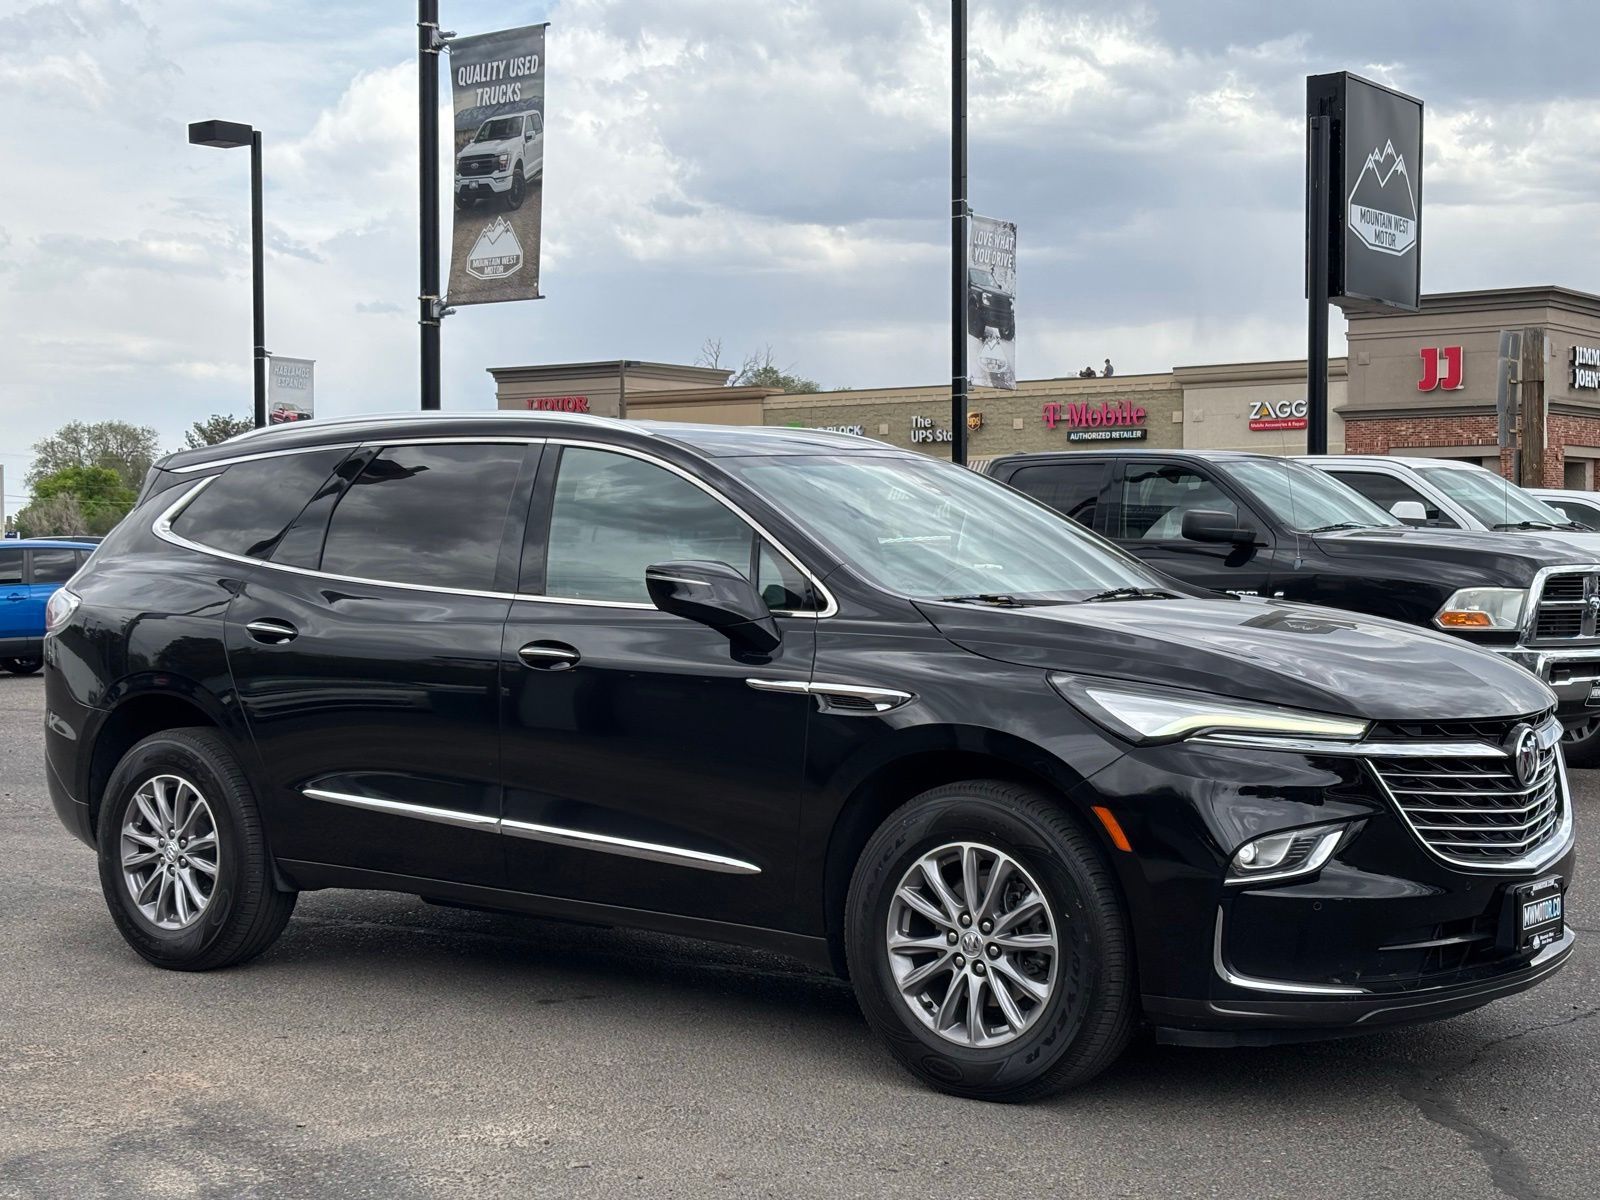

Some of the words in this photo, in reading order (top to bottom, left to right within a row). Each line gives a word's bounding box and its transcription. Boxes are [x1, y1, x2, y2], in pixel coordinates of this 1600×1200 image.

[458, 60, 506, 86] QUALITY
[509, 55, 539, 77] USED
[476, 82, 521, 106] TRUCKS
[1360, 208, 1393, 229] MOUNTAIN
[1393, 216, 1409, 234] WEST
[974, 230, 993, 246] LOVE
[994, 233, 1014, 251] WHAT
[1374, 228, 1396, 247] MOTOR
[472, 257, 501, 268] MOUNTAIN
[501, 255, 517, 265] WEST
[974, 247, 990, 264] YOU
[991, 251, 1013, 268] DRIVE
[484, 265, 504, 275] MOTOR
[1574, 345, 1600, 367] JIMM
[274, 365, 310, 378] HABLAMOS
[1249, 400, 1307, 419] ZAGG
[911, 415, 933, 428] The
[911, 431, 933, 443] UPS
[935, 431, 953, 442] Sto
[1070, 432, 1111, 440] AUTHORIZED
[1111, 430, 1142, 438] RETAILER
